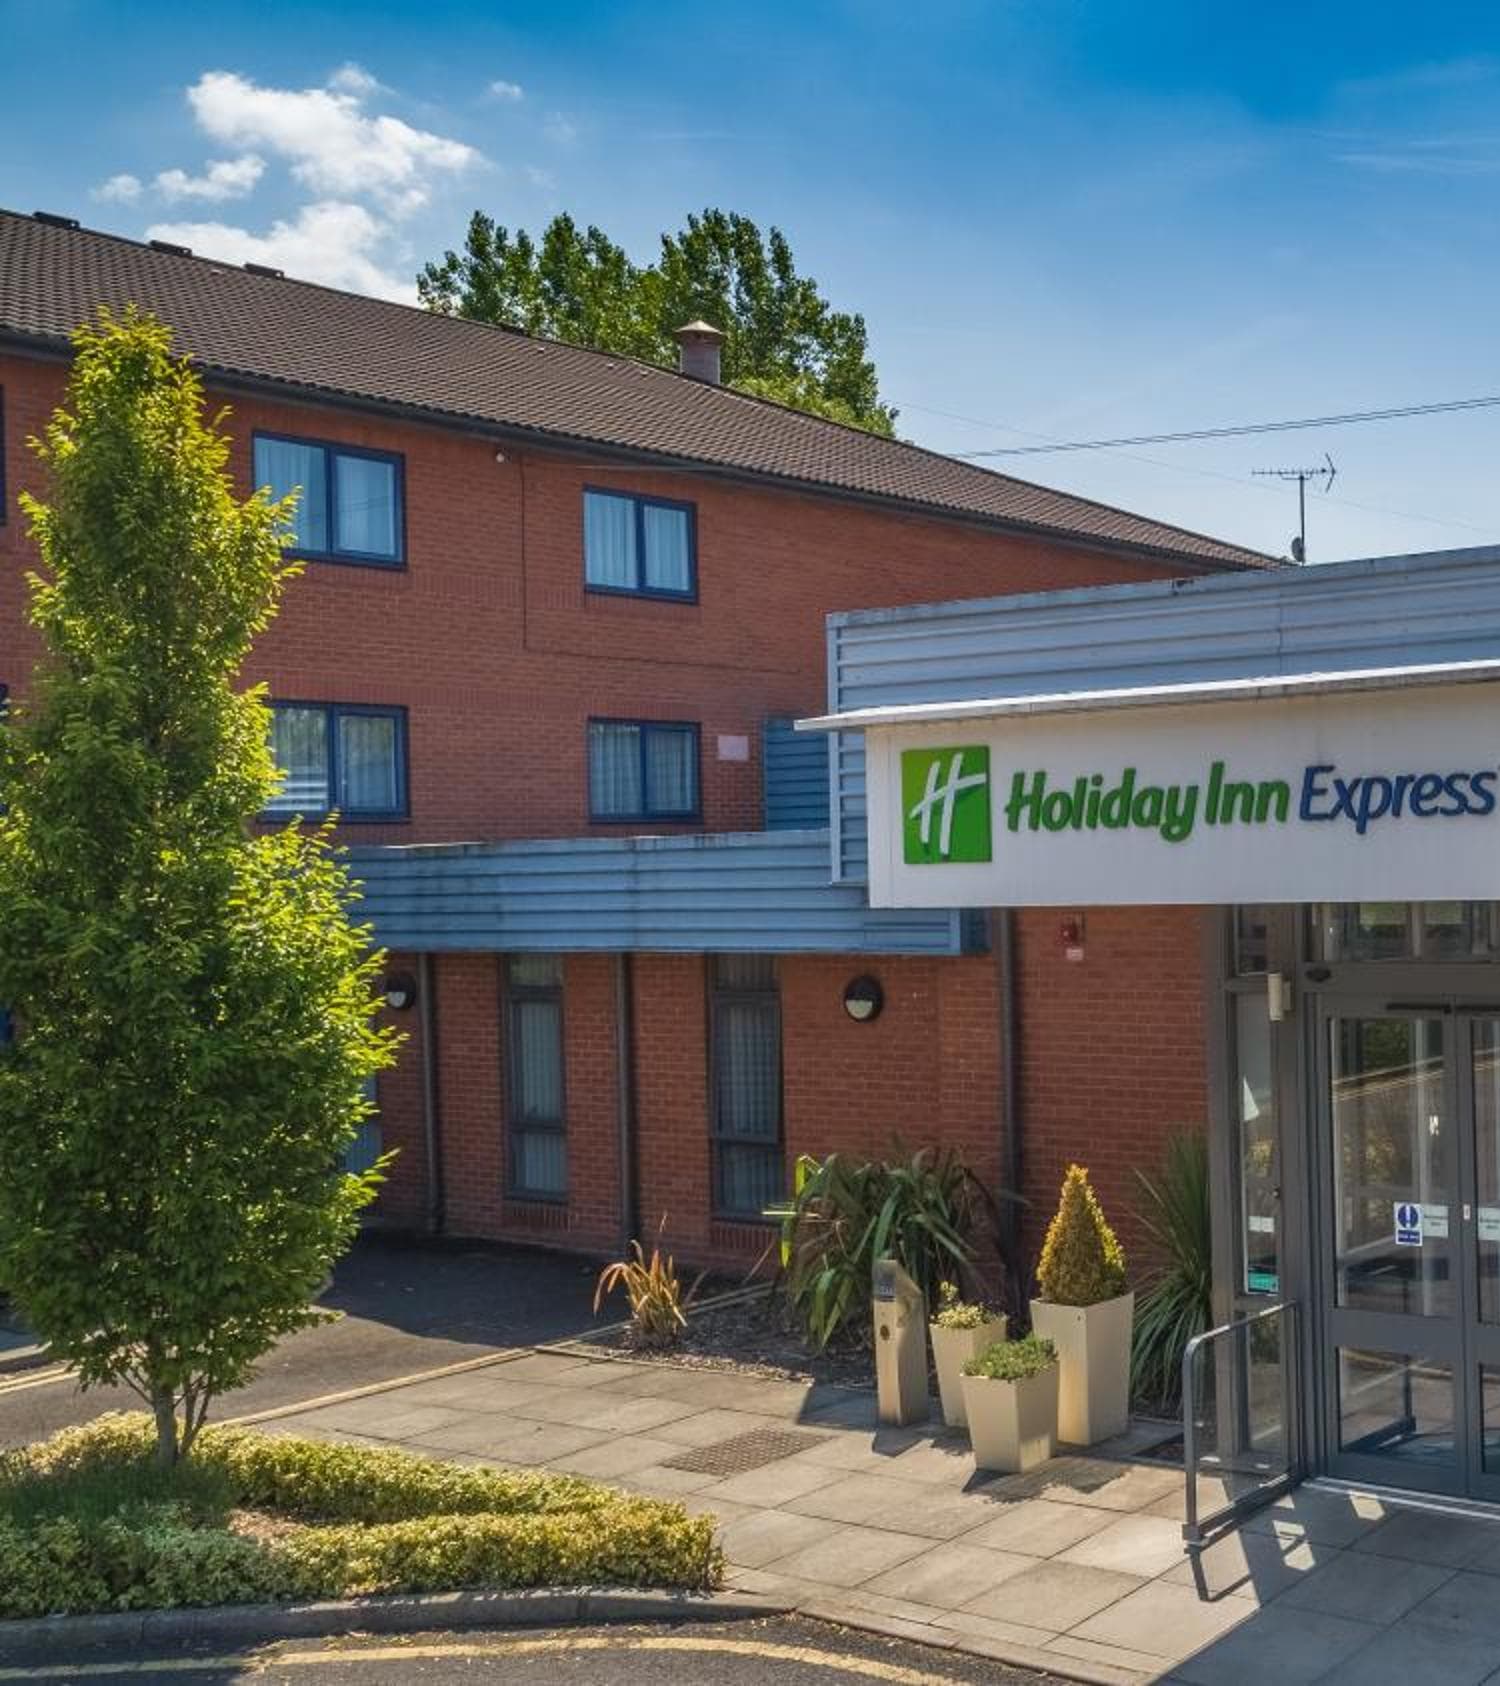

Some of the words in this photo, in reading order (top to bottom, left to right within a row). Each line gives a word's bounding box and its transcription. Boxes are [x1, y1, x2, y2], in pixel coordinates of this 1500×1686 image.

[1004, 767, 1199, 842] Holiday
[1204, 761, 1290, 826] Inn
[1300, 765, 1498, 835] Express
